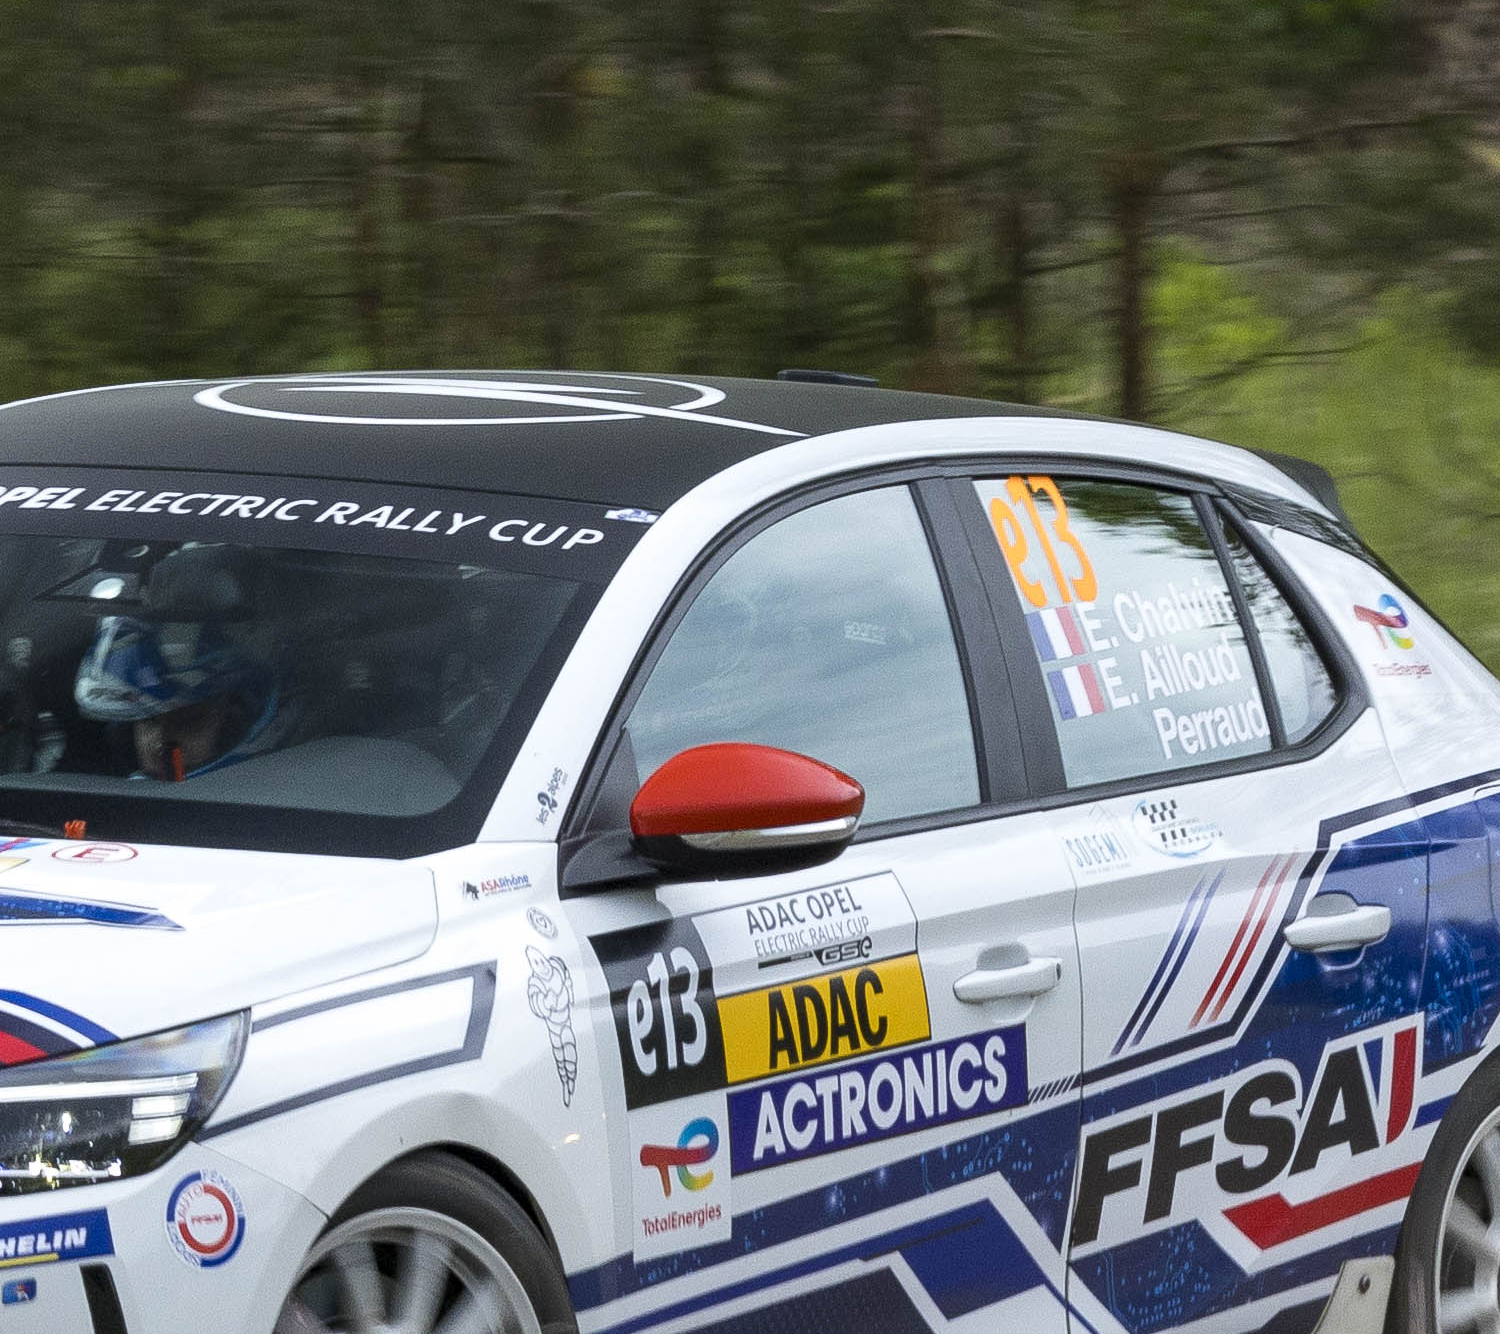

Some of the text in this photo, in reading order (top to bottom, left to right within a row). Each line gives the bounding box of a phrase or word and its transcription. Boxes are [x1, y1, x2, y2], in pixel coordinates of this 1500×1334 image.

[83, 489, 318, 521] ELECTRIC
[314, 501, 485, 536] RALLY
[488, 519, 605, 550] CUP
[989, 475, 1098, 608] e13
[1075, 577, 1236, 652] E. Chalvin
[1098, 632, 1241, 710] E. Ailloud
[1152, 687, 1270, 760] Perraud
[746, 886, 862, 935] ADAC OPEL
[754, 929, 809, 957] ELECTRIC
[808, 921, 844, 948] RALLY
[846, 915, 869, 937] CUP
[627, 946, 707, 1076] e13
[767, 968, 888, 1070] ADAC
[753, 1035, 1008, 1161] ACTRONICS
[1070, 1043, 1381, 1249] FFSA
[642, 1203, 722, 1236] TotalEnergies
